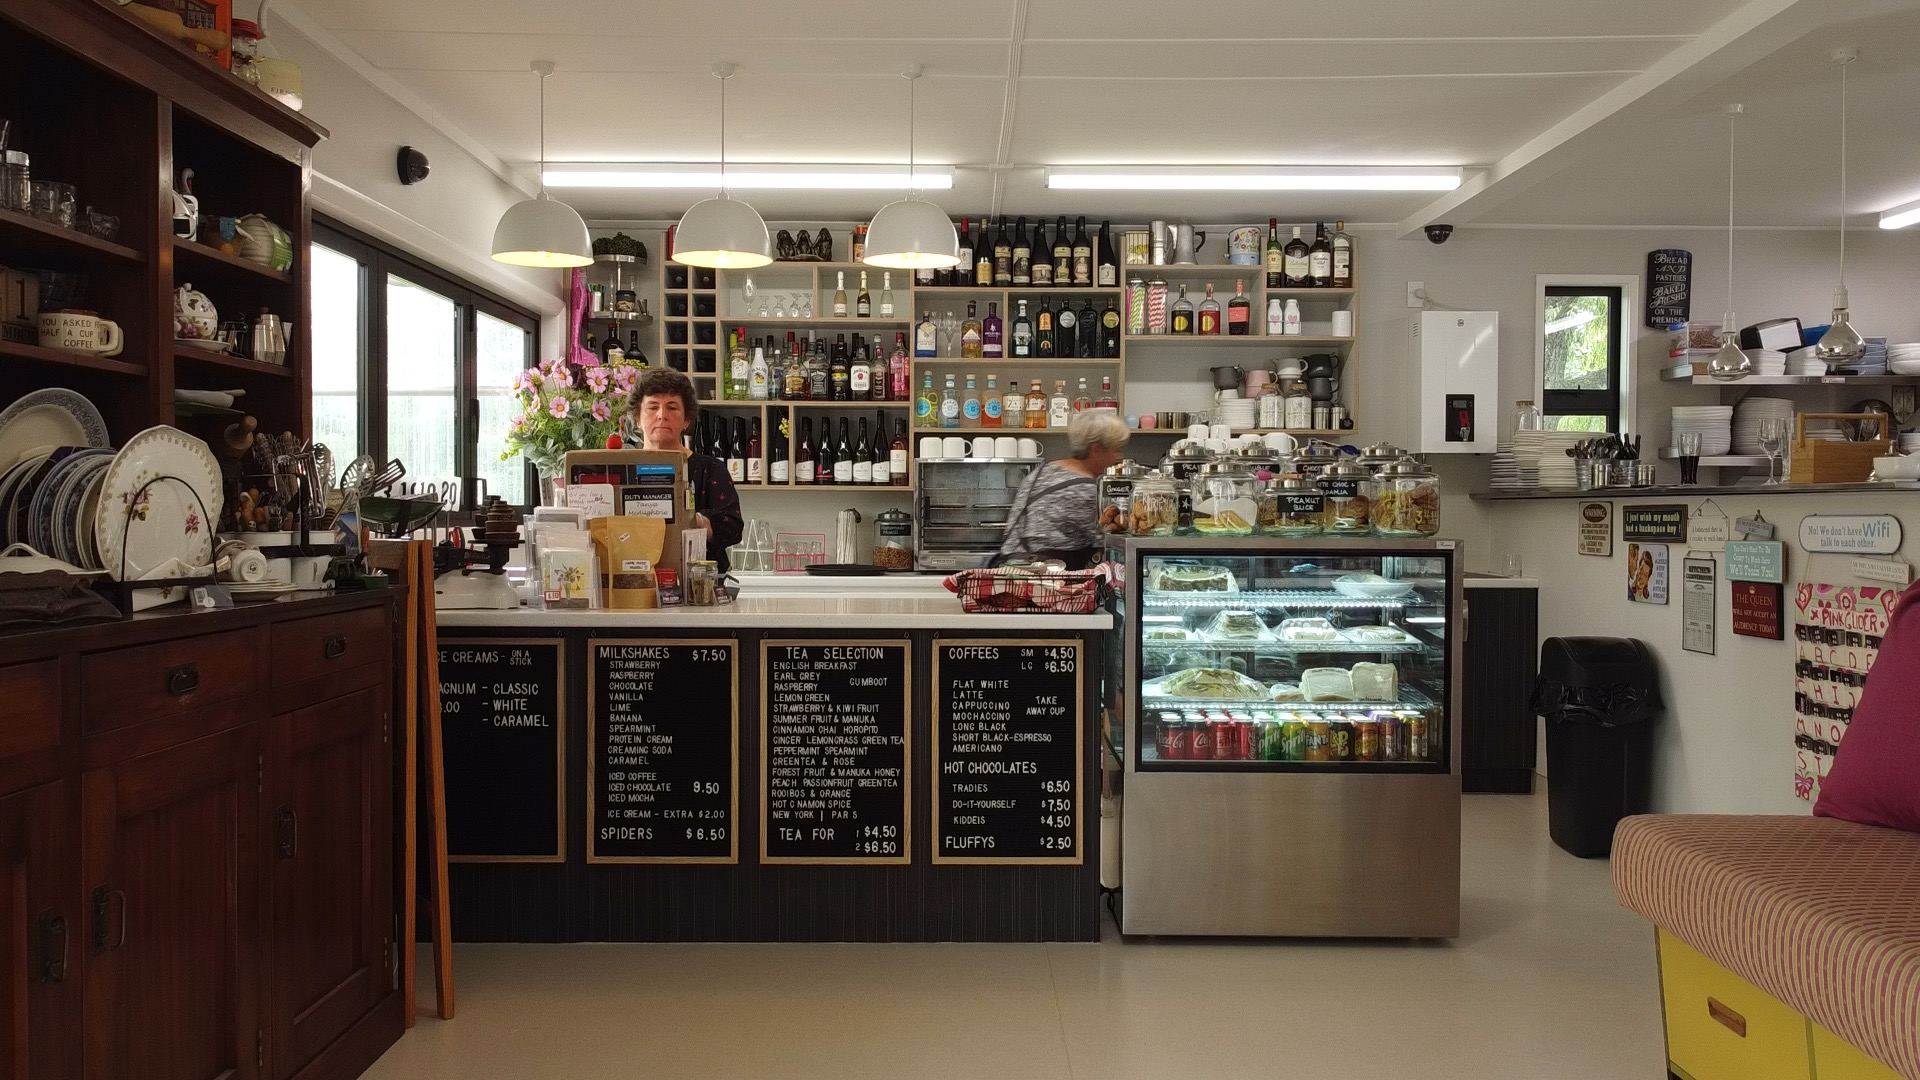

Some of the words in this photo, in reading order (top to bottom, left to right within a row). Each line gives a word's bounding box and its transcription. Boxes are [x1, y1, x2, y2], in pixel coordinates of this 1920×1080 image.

[1654, 254, 1687, 264] BREAD
[1652, 284, 1686, 298] BAKED
[42, 318, 56, 326] YOU
[63, 319, 91, 328] ASKED
[80, 330, 93, 338] CUP
[64, 340, 93, 348] COFFEE
[1286, 497, 1320, 505] PEANUT
[1639, 524, 1665, 534] backspace
[1808, 526, 1818, 535] No!
[1820, 526, 1829, 535] We
[1831, 526, 1846, 535] don't
[1847, 526, 1862, 536] have
[1862, 520, 1889, 538] Wifi
[1821, 538, 1832, 547] talk
[1834, 538, 1840, 547] to
[1841, 538, 1855, 547] each
[1736, 594, 1748, 604] THE
[1750, 595, 1772, 607] QUEEN
[1734, 621, 1757, 630] AUDIENCE
[1759, 624, 1776, 634] TODAY
[453, 651, 499, 663] CREAMS
[600, 647, 670, 659] MILKSHAKES
[692, 649, 726, 661] $7.50
[786, 647, 808, 660] TEA
[824, 647, 884, 660] SELECTION
[949, 647, 999, 660] COFFEES
[1021, 648, 1033, 657] SM
[1044, 647, 1074, 659] $4.50
[610, 661, 660, 669] STRAWBERRY
[774, 662, 809, 670] ENGLISH
[814, 662, 857, 670] BREAKFAST
[1021, 662, 1033, 670] LG
[1045, 661, 1074, 673] $6.50
[610, 672, 654, 680] RASPBERRY
[774, 672, 796, 680] EARL
[800, 672, 820, 680] GREY
[609, 682, 654, 690] CHOCOLATE
[850, 678, 888, 686] GUMBOOT
[953, 680, 974, 688] FLAT
[981, 680, 1009, 688] WHITE
[440, 683, 476, 694] AGNUM
[493, 683, 539, 695] CLASSIC
[774, 683, 818, 691] RASPBERRY
[609, 693, 644, 701] VANILLA
[774, 694, 802, 702] LEMON
[805, 694, 830, 702] GREEN
[953, 691, 984, 699] LATTE
[1035, 696, 1057, 704] TAKE
[493, 699, 527, 711] WHITE
[610, 703, 631, 712] LIME
[774, 704, 825, 712] STRAWBERRY
[836, 704, 854, 712] KIWI
[857, 704, 879, 712] FRUIT
[952, 701, 1010, 710] CAPPUCCINO
[1026, 707, 1046, 715] AWAY
[1050, 707, 1066, 715] CUP
[610, 714, 642, 722] BANANA
[773, 715, 807, 724] SUMMER
[811, 715, 832, 723] FRUIT
[842, 715, 875, 724] MANUKA
[953, 712, 1011, 720] MOCHACCINO
[494, 715, 549, 727] CARAMEL
[609, 724, 656, 733] SPEARMINT
[773, 726, 814, 734] CINNAMON
[818, 726, 836, 734] CHAI
[953, 723, 974, 731] LONG
[979, 723, 1006, 731] BLACK
[609, 735, 642, 744] PROTEIN
[647, 735, 672, 744] CREAM
[773, 736, 801, 744] GINGER
[807, 736, 858, 744] LEMONGRASS
[862, 736, 887, 745] GREEN
[890, 736, 904, 744] TEA
[952, 733, 979, 742] SHORT
[608, 746, 648, 754] CREAMING
[652, 746, 672, 754] SODA
[774, 747, 820, 755] PEPPERMINT
[825, 747, 868, 756] SPEARMINT
[952, 744, 1002, 753] AMERICANO
[608, 756, 649, 765] CARAMEL
[834, 757, 855, 765] ROSE
[772, 768, 800, 776] FOREST
[804, 768, 825, 776] FRUIT
[838, 768, 870, 776] MANUKA
[874, 768, 900, 776] HONEY
[944, 762, 964, 774] HOT
[968, 762, 1037, 774] CHOCOLATES
[609, 772, 625, 780] ICED
[628, 772, 657, 780] COFFEE
[772, 778, 796, 787] PEACH
[803, 778, 854, 787] PASSIONFRUIT
[953, 784, 988, 792] TRADIES
[1041, 780, 1070, 793] $6.50
[609, 783, 625, 791] ICED
[627, 783, 671, 792] CHOCOLATE
[609, 794, 626, 802] ICED
[628, 794, 655, 802] MOCHA
[772, 789, 805, 798] ROOIBOS
[820, 789, 851, 798] ORANGE
[773, 800, 786, 808] HOT
[828, 800, 851, 809] SPICE
[1042, 799, 1070, 812] $7.50
[608, 810, 620, 818] ICE
[624, 810, 651, 818] CREAM
[664, 810, 693, 818] EXTRA
[699, 810, 725, 818] $2.00
[773, 811, 790, 819] NEW
[795, 811, 814, 819] YORK
[1041, 815, 1071, 828] $4.50
[601, 827, 653, 840] SPIDERS
[780, 828, 802, 840] TEA
[812, 828, 834, 840] FOR
[865, 825, 896, 838] $4.50
[865, 841, 896, 853] $6.50
[946, 836, 995, 849] FLUFFYS
[1040, 836, 1071, 849] $2.50
